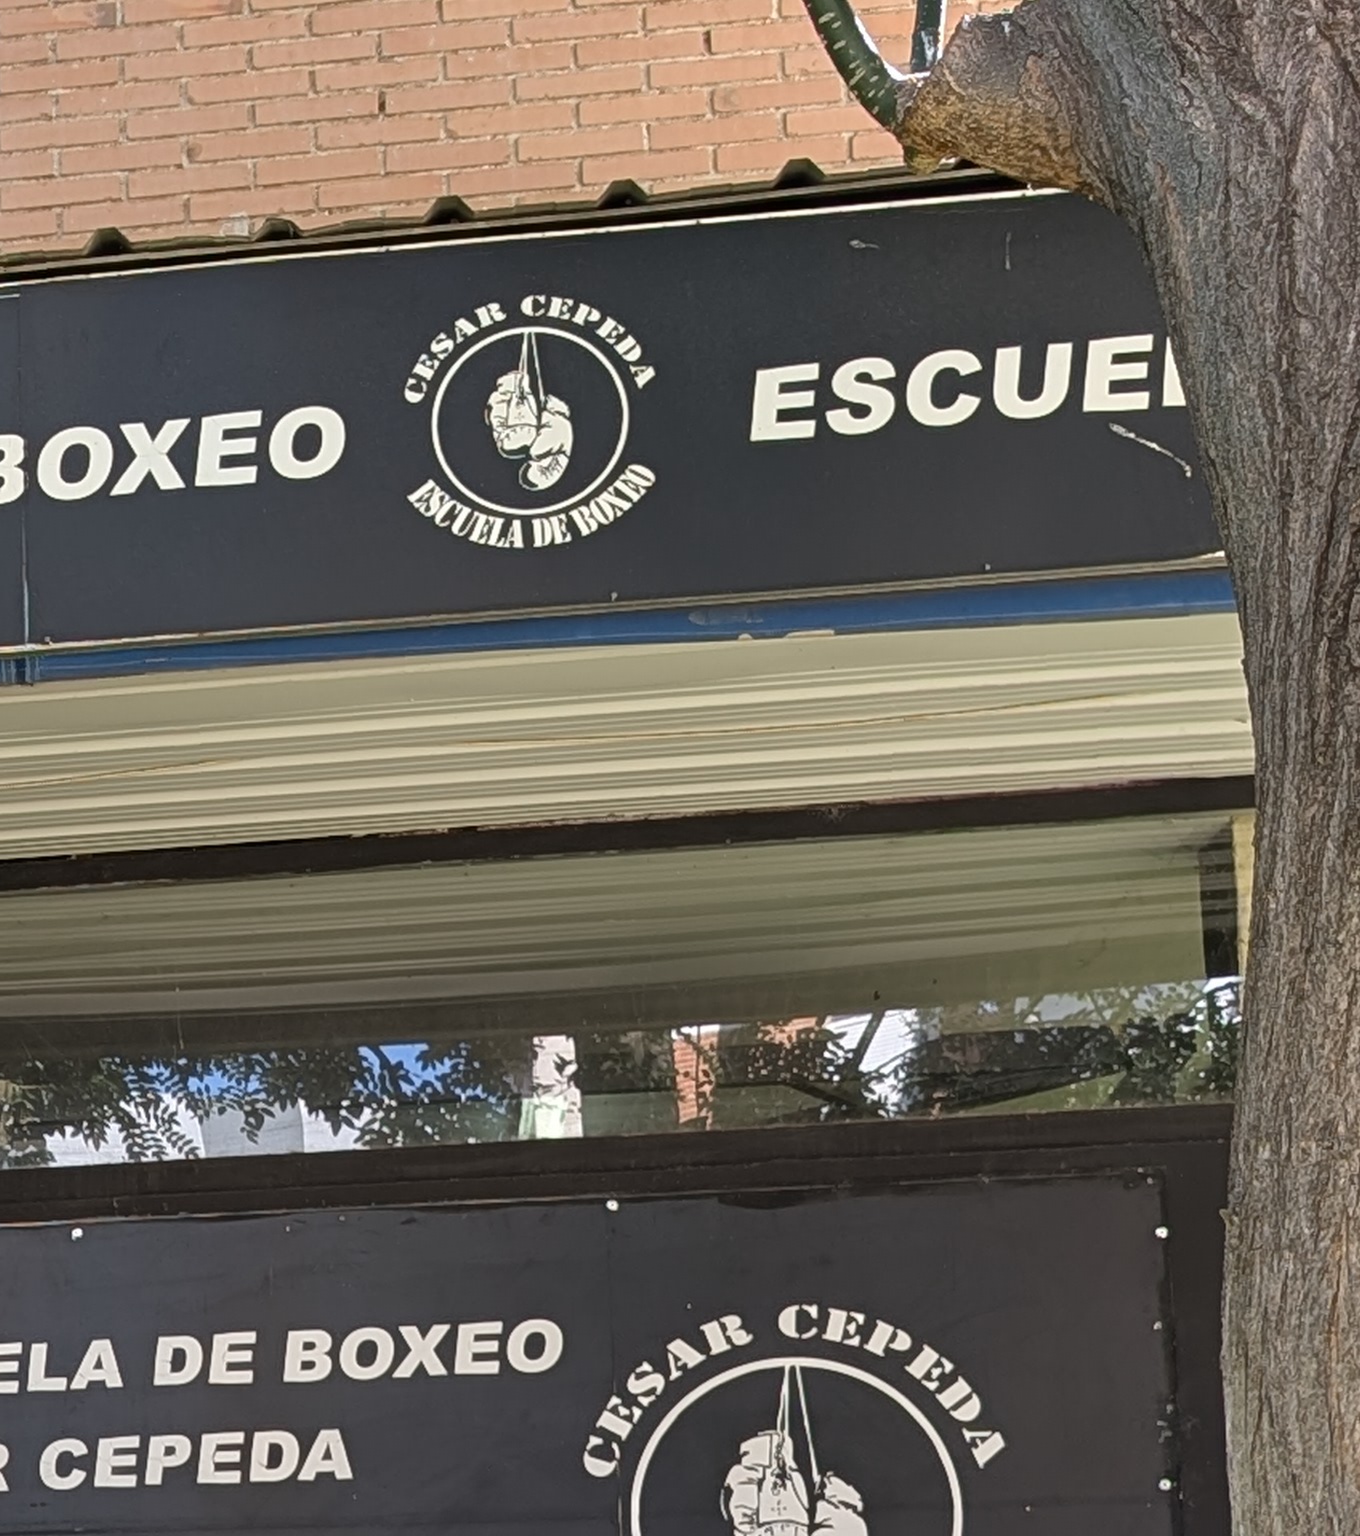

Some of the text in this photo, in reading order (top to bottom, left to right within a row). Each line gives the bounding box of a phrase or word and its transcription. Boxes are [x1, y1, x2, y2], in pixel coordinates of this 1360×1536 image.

[404, 295, 656, 404] CESAR CEPEDA
[406, 464, 657, 549] ESCUELA DE BOXEO
[153, 1330, 257, 1386] DE
[283, 1318, 564, 1383] BOXEO
[583, 1304, 1007, 1479] CESAR CEPEDA
[39, 1428, 353, 1490] CEPEDA
